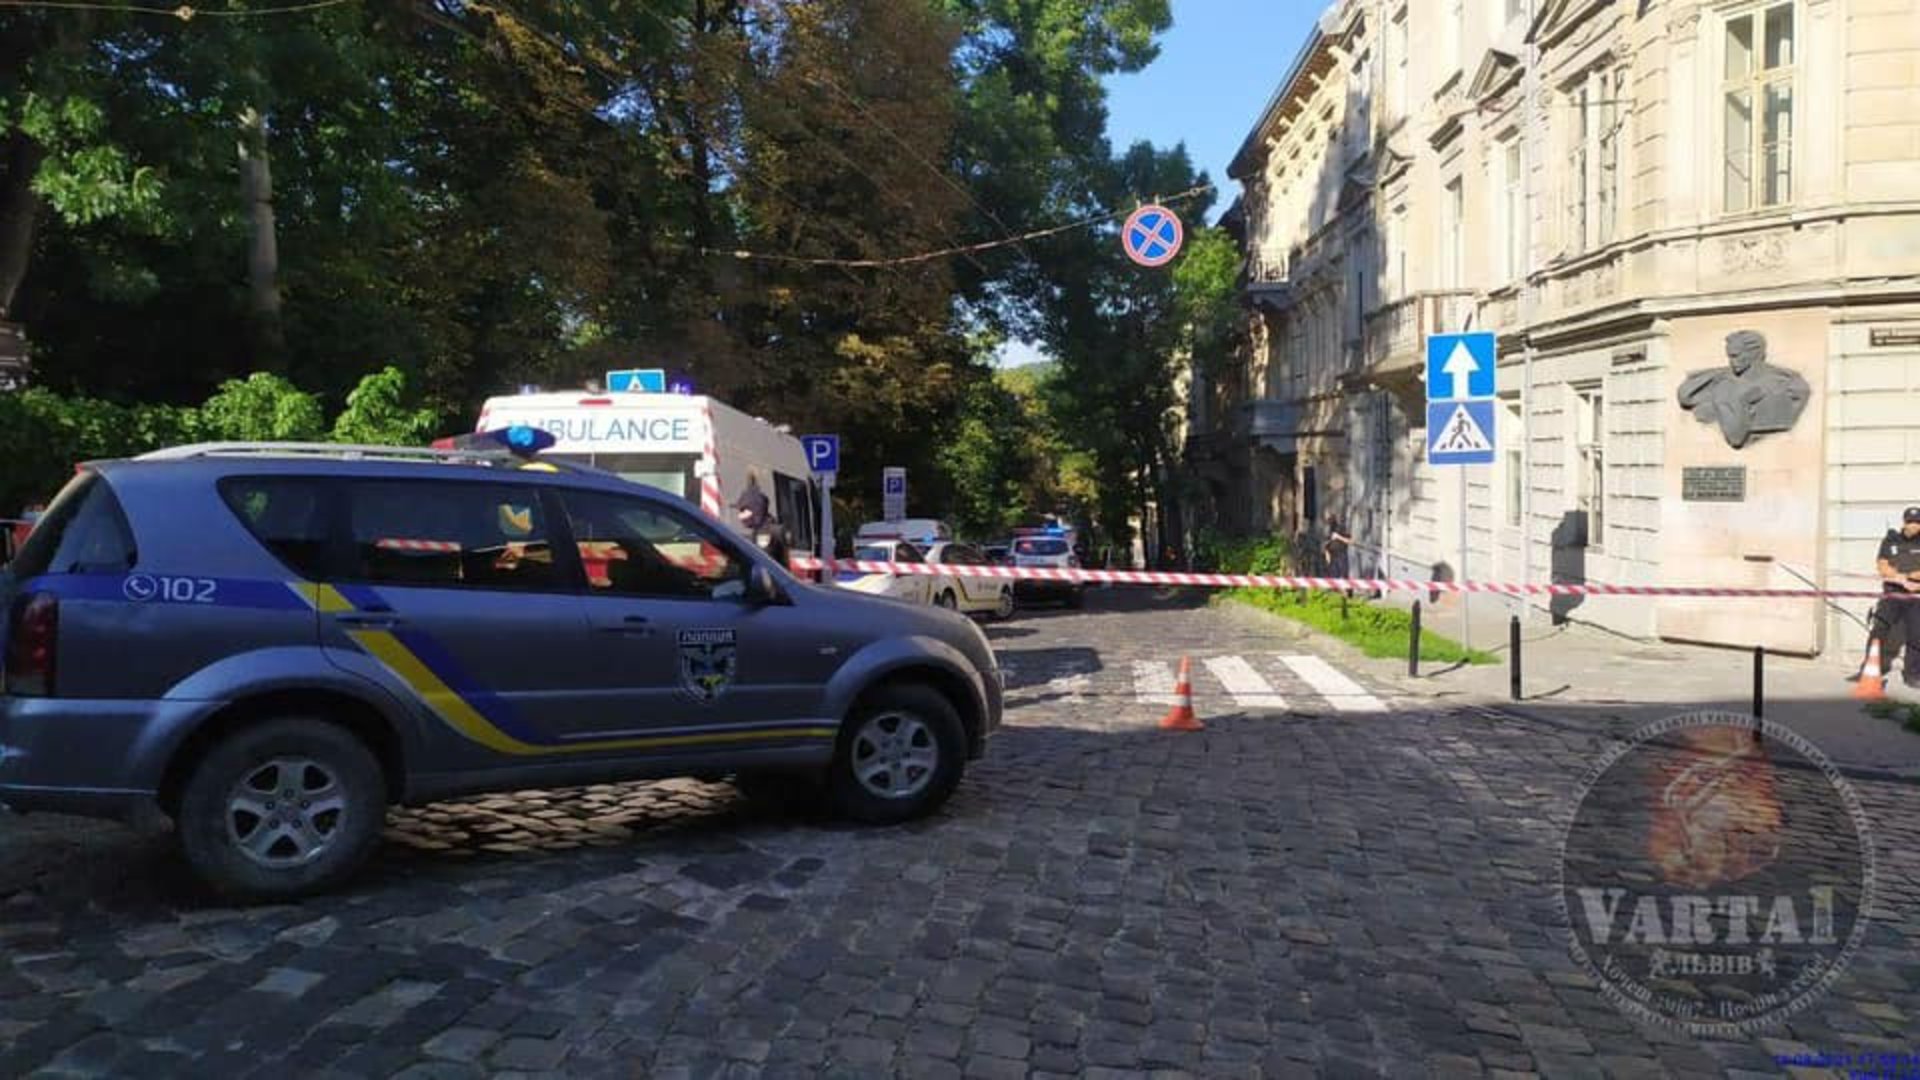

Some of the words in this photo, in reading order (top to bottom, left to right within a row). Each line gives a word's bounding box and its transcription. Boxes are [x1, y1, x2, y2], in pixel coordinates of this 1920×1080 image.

[510, 419, 689, 441] BULANCE
[812, 440, 831, 468] P
[889, 479, 900, 494] P
[160, 577, 217, 602] 102
